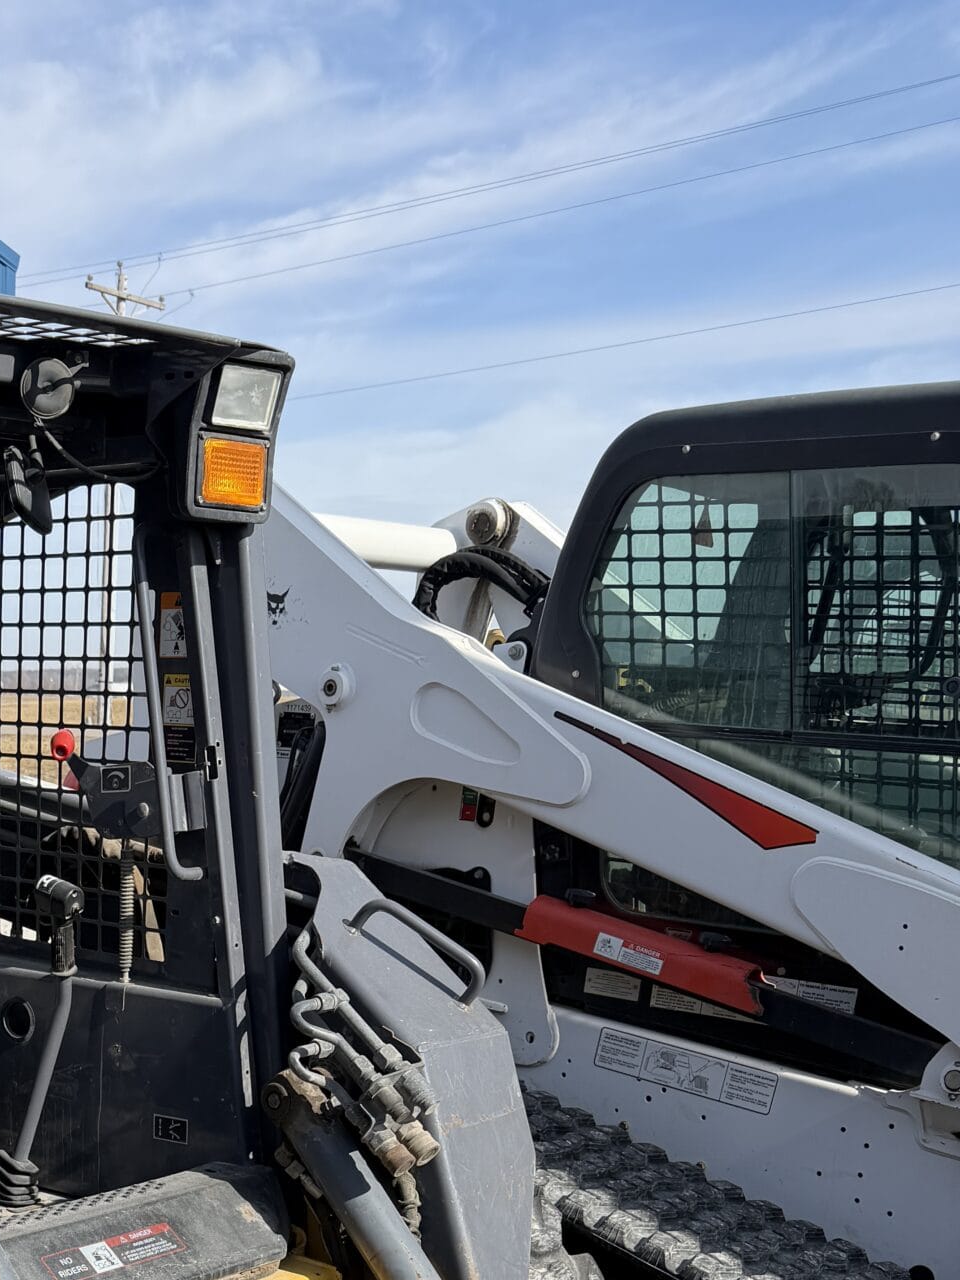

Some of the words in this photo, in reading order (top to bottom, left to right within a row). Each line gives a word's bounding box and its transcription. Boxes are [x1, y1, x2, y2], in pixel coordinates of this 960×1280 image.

[635, 945, 661, 959] DANGER
[59, 1257, 73, 1266] NO
[57, 1264, 89, 1278] RIDERS
